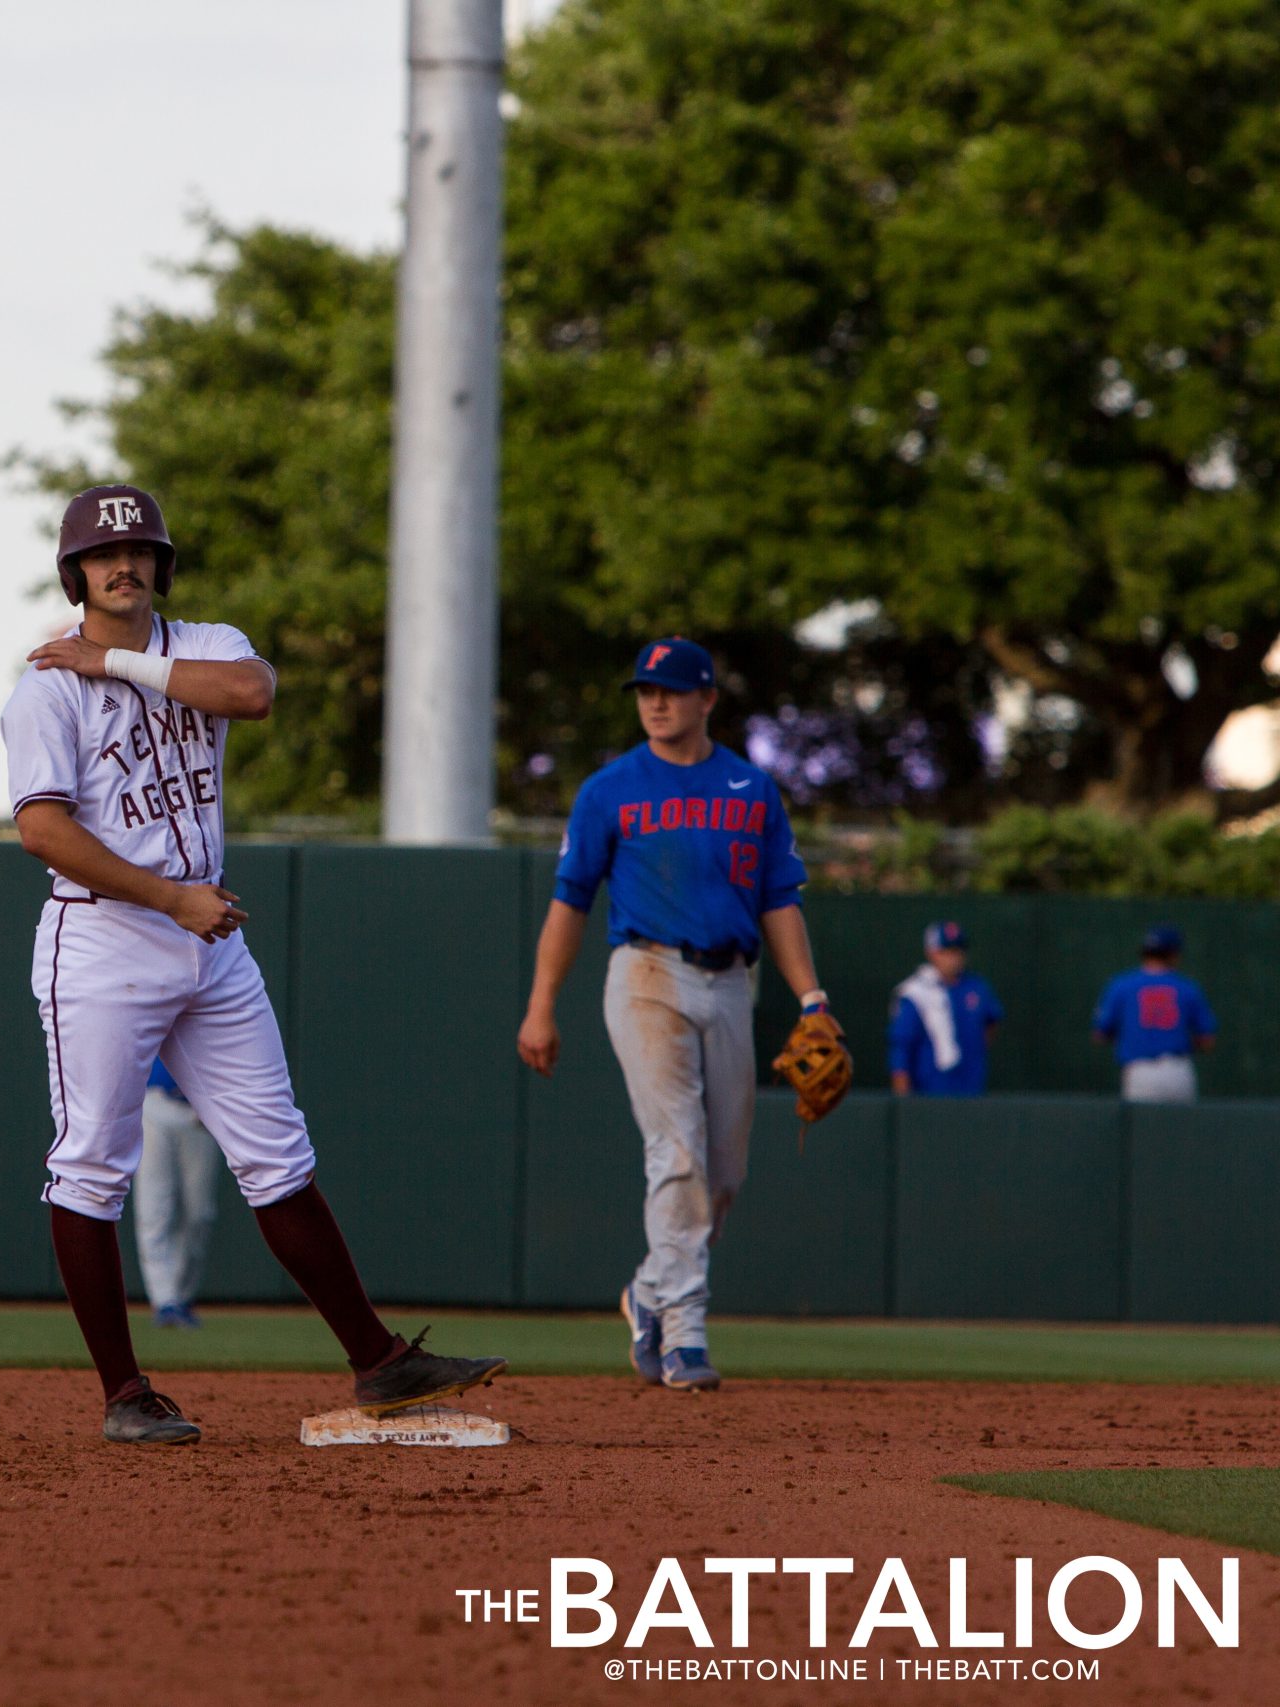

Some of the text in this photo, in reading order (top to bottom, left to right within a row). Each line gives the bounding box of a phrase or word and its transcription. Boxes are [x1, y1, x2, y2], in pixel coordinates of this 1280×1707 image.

[645, 644, 671, 671] F
[100, 706, 216, 777] TEXAS
[120, 764, 217, 829] AGGIE
[619, 797, 767, 840] FLORIDA
[728, 839, 759, 889] 12
[385, 1433, 417, 1442] TEXAS
